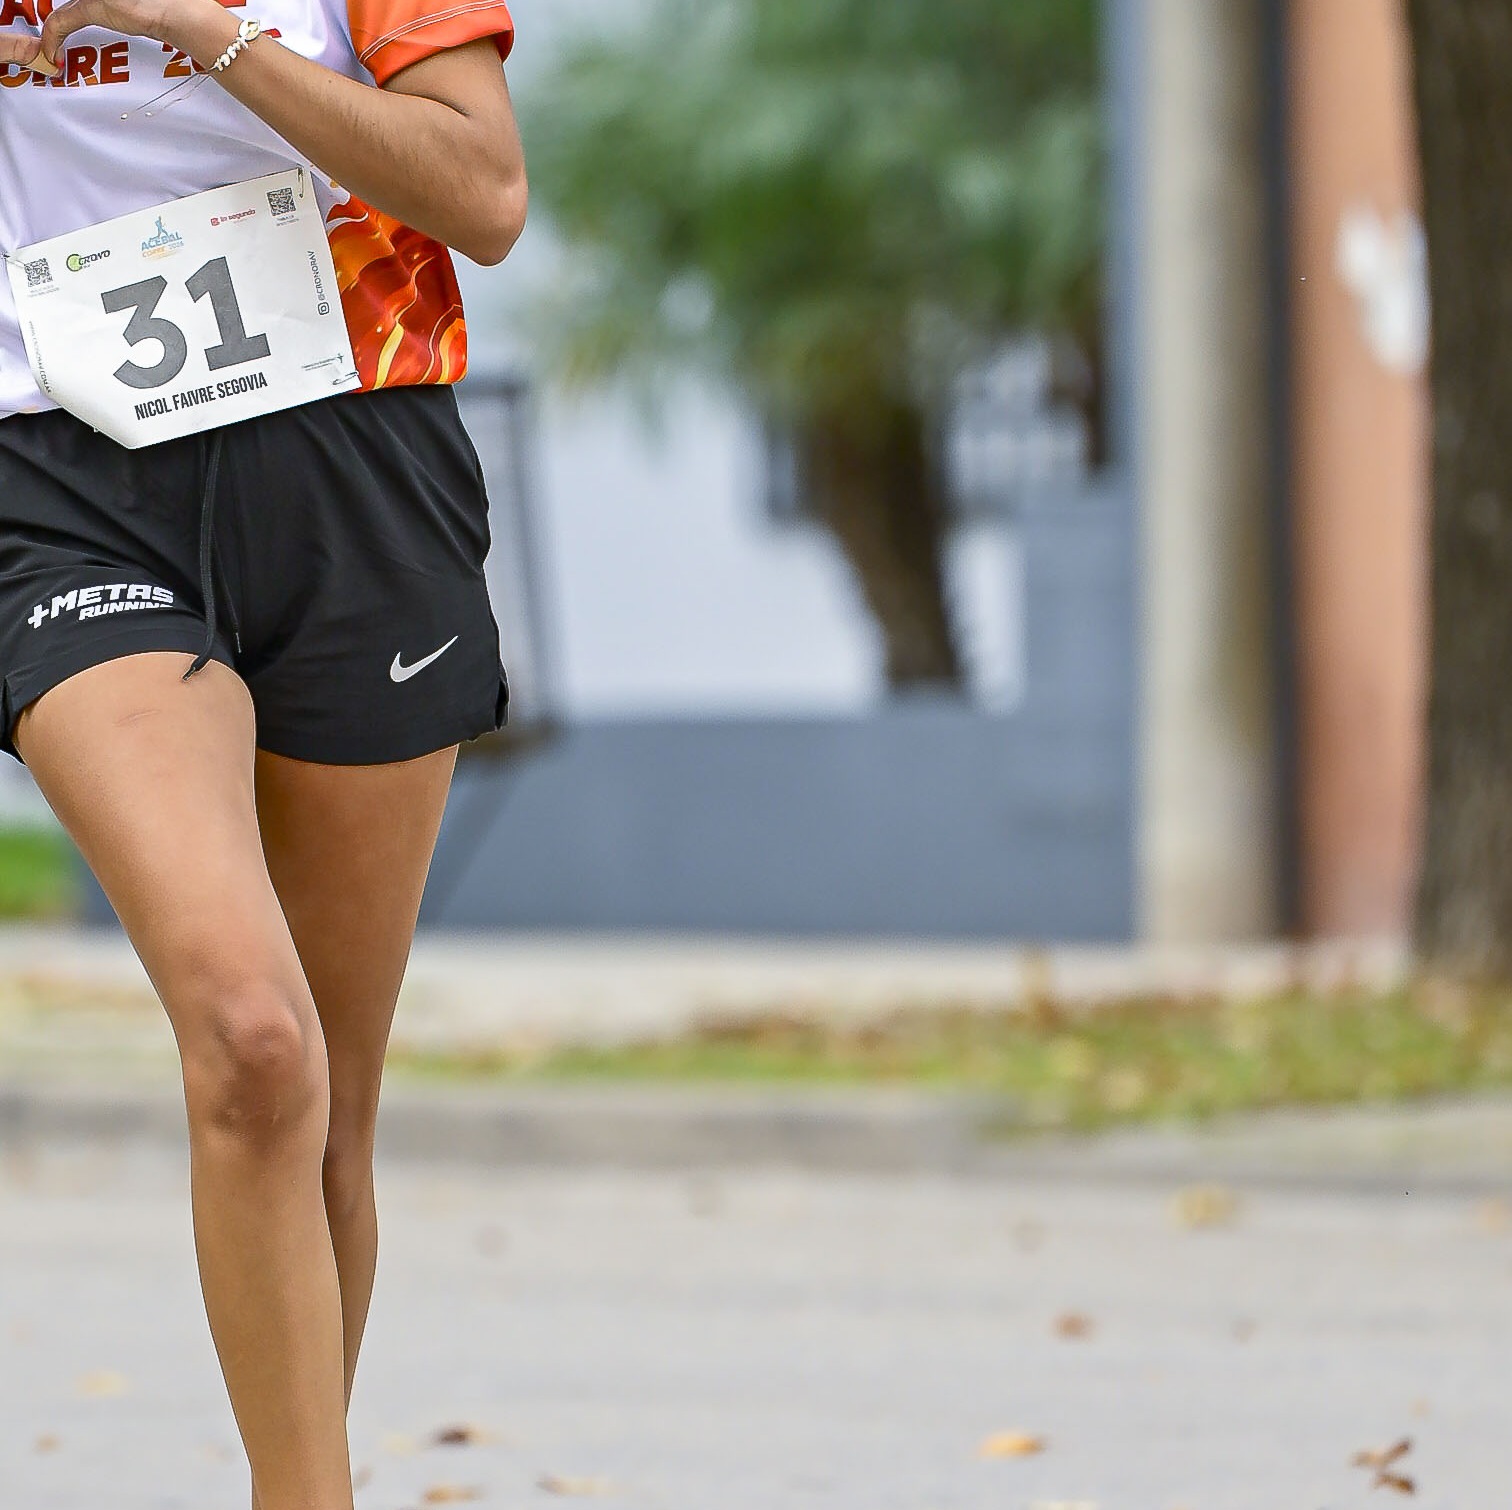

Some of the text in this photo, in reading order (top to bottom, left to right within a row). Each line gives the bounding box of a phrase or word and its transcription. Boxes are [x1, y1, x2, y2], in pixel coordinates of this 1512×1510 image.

[142, 231, 182, 251] ACEBAL
[101, 256, 271, 389] 31
[134, 372, 268, 420] NICOL FAIVRE SEGOVIA
